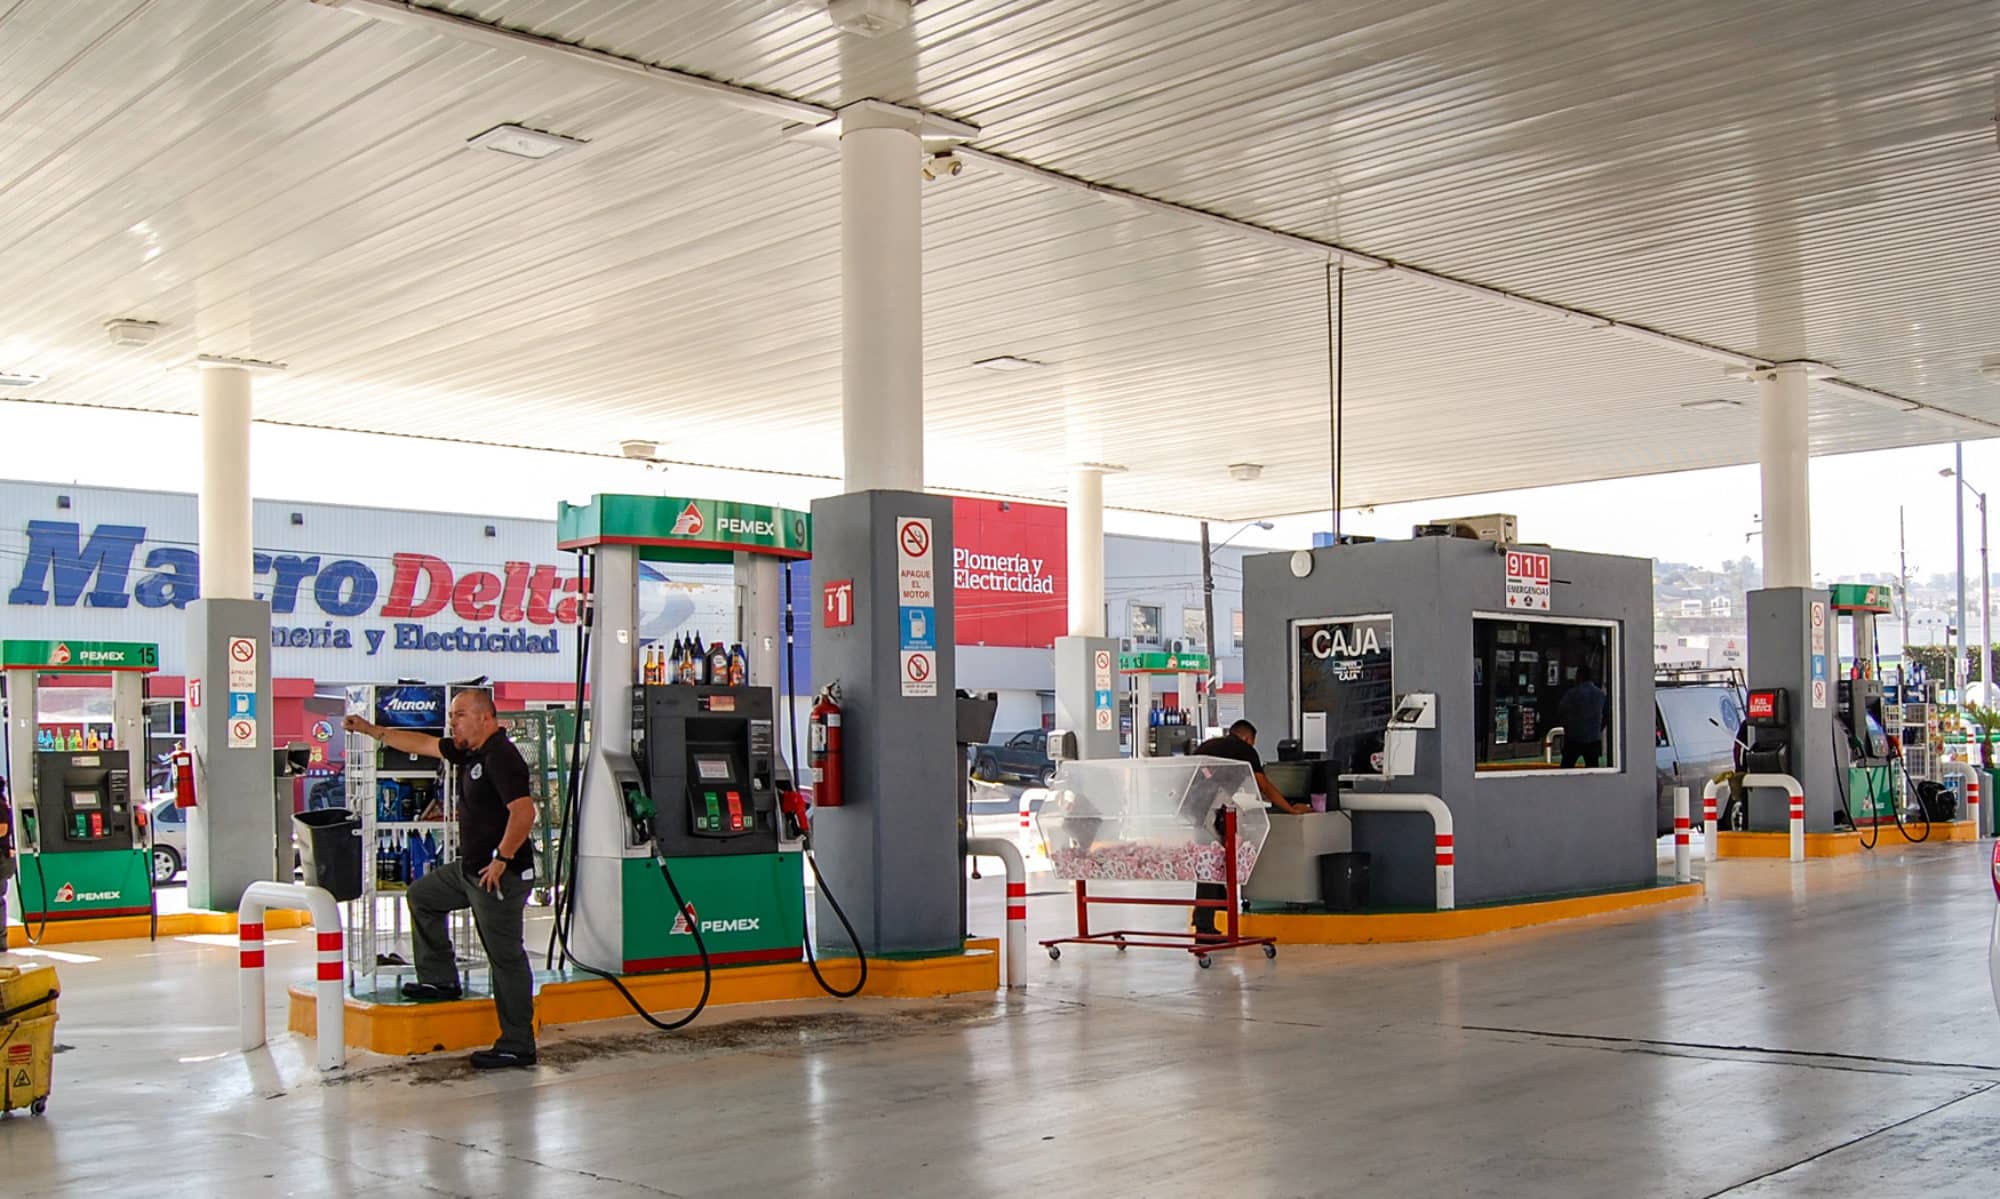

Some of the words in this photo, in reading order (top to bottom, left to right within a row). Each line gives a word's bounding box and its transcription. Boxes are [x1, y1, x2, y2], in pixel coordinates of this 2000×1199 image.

[717, 518, 775, 537] PEMEX
[795, 519, 805, 547] 9
[953, 548, 1029, 573] Plomería
[1032, 558, 1044, 578] y
[1509, 555, 1546, 578] 911
[901, 570, 930, 578] APAGUE
[953, 568, 1055, 595] Electricidad
[911, 580, 921, 588] EL
[1507, 584, 1549, 597] EMERGENCIAS
[903, 590, 930, 599] MOTOR
[365, 629, 386, 655] y
[394, 623, 560, 654] Electricidad
[1312, 627, 1381, 660] CAJA
[79, 651, 125, 662] PEMEX
[138, 647, 155, 665] 15
[384, 698, 436, 712] AKRON
[77, 890, 120, 902] PEMEX
[701, 917, 760, 934] PEMEX
